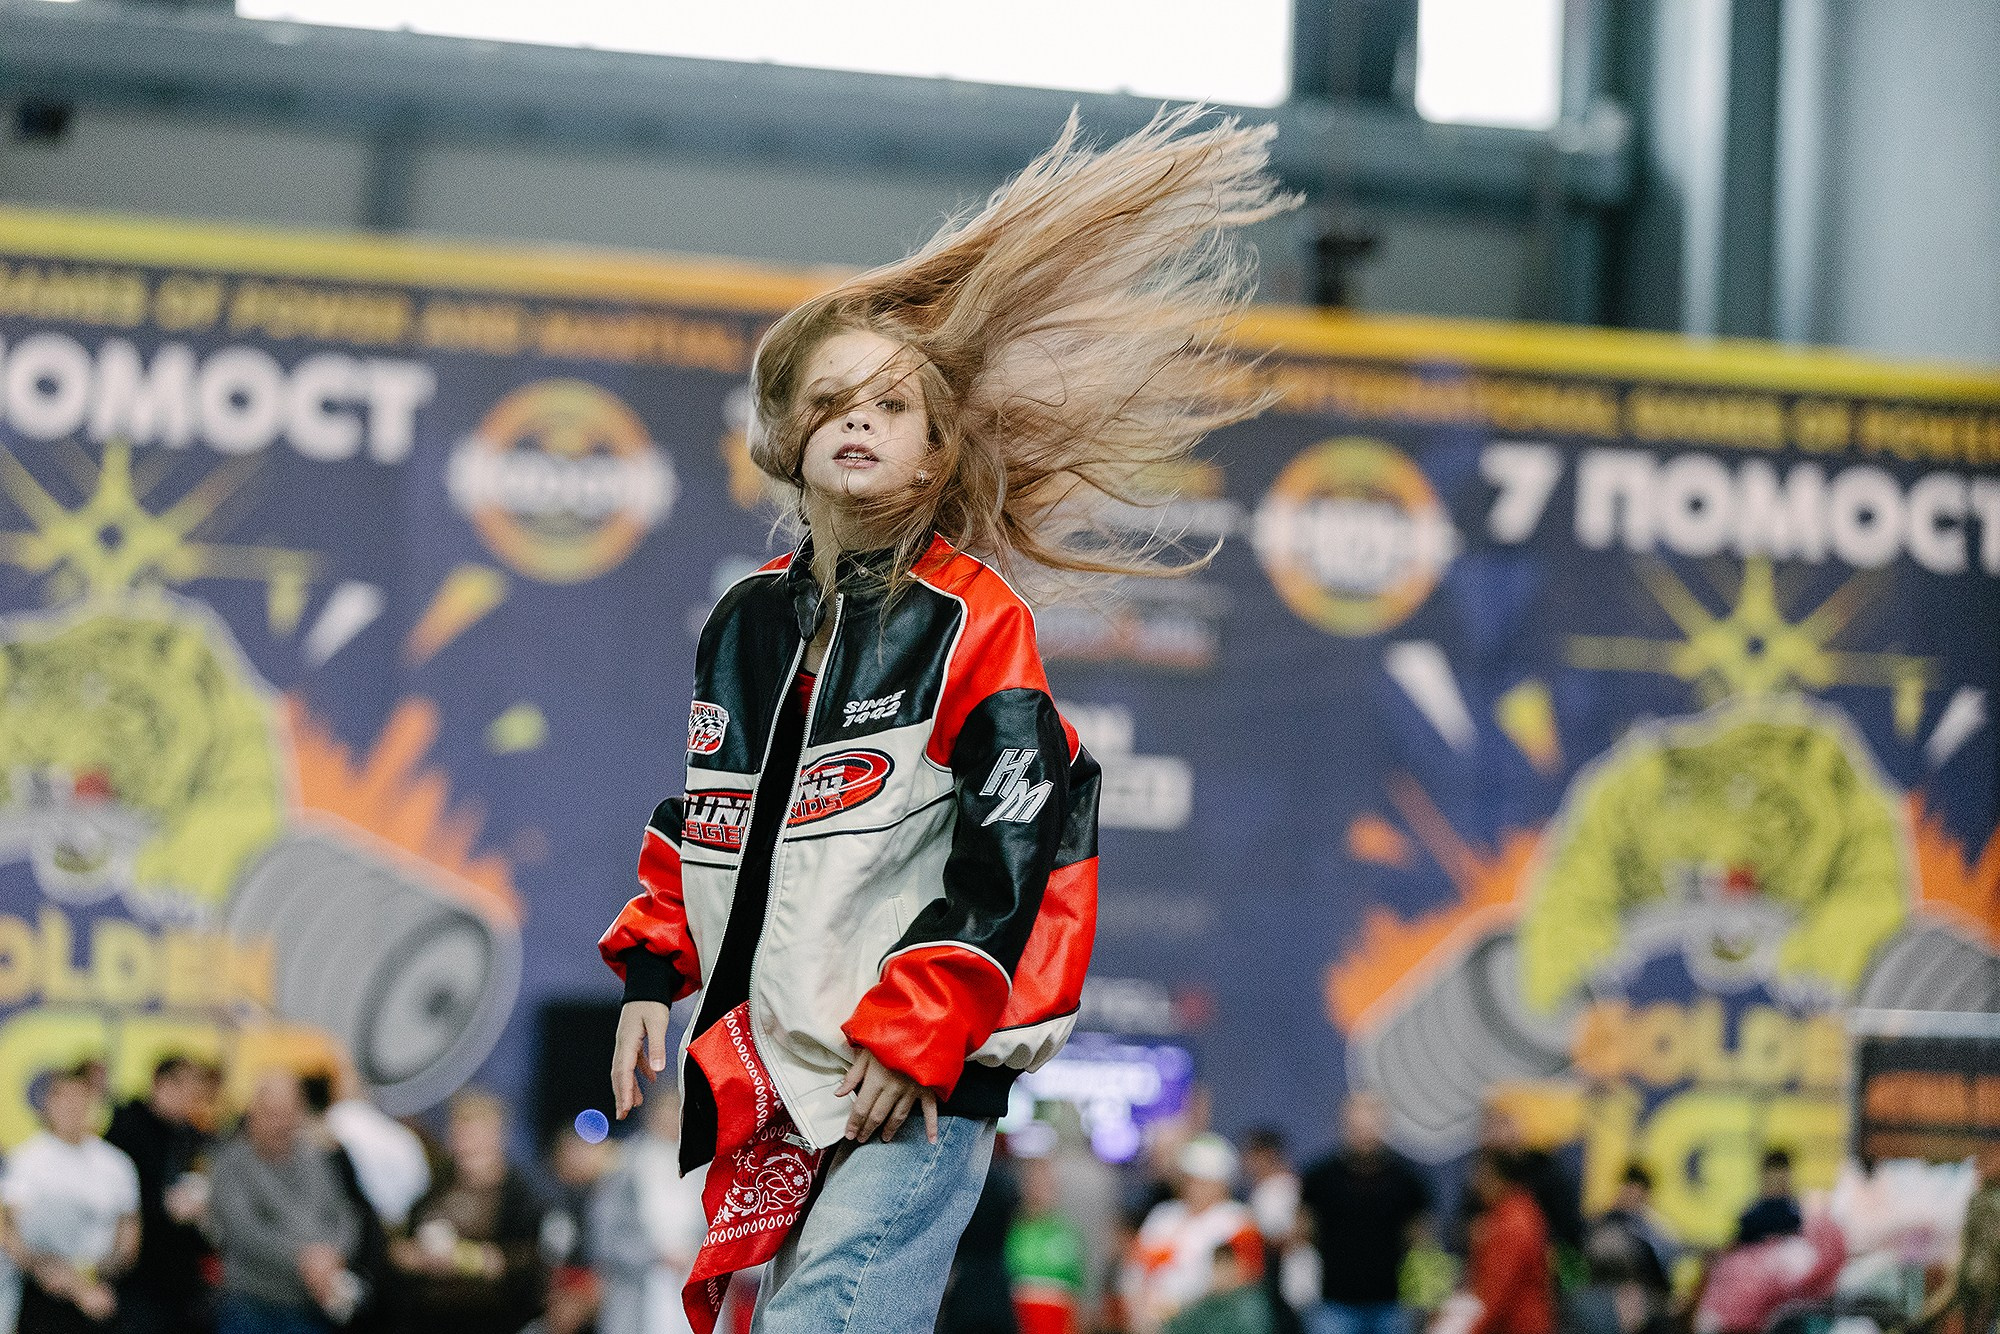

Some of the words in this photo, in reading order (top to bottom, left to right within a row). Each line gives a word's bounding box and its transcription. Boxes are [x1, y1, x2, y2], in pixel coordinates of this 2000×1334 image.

[0, 332, 436, 464] ОМОСТ
[1479, 440, 1563, 545] 7
[843, 689, 906, 714] SINCE
[681, 819, 746, 845] EGE
[1568, 1000, 1848, 1086] GOLDE
